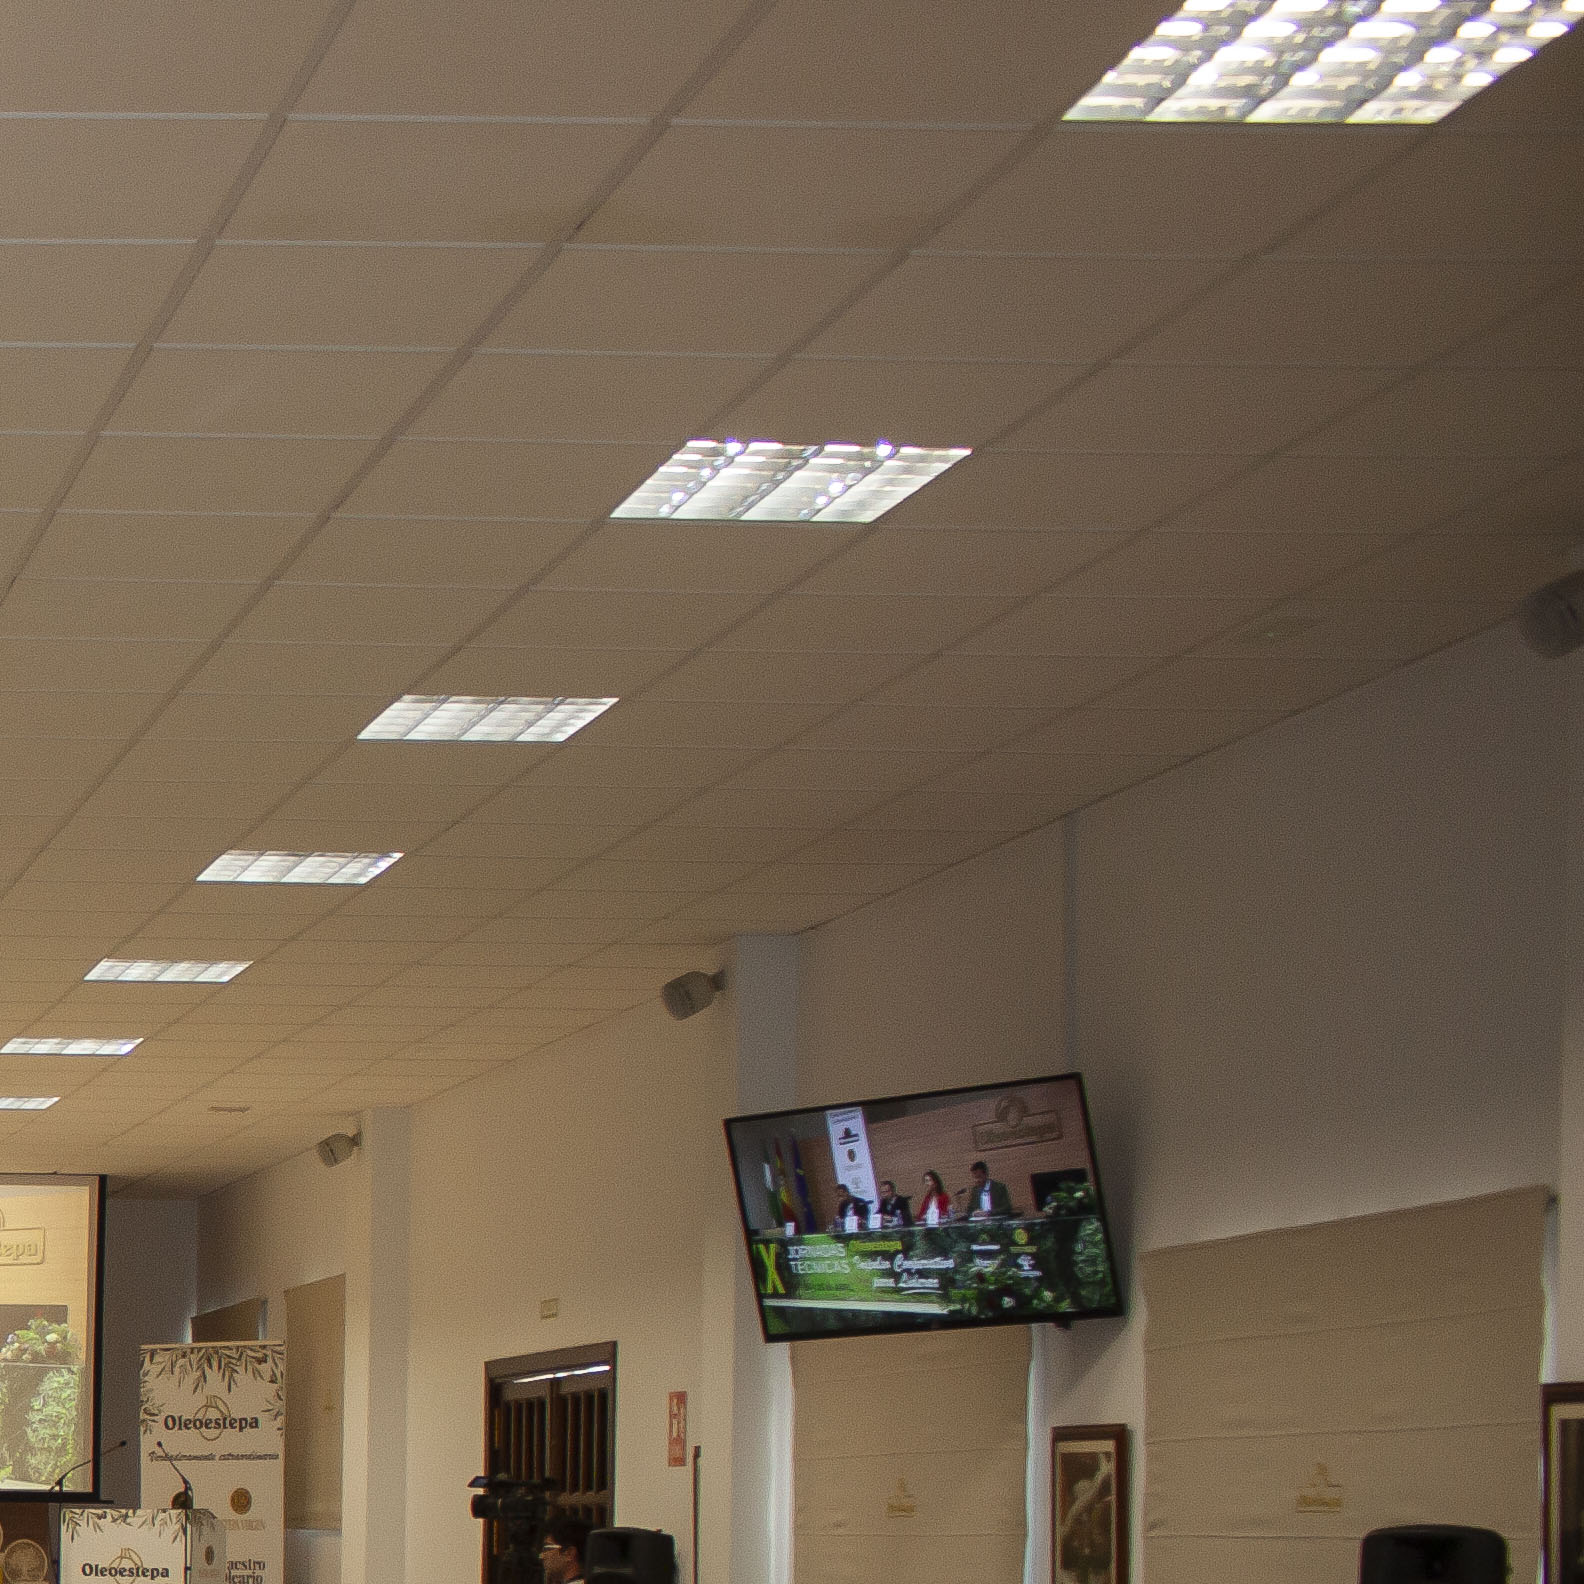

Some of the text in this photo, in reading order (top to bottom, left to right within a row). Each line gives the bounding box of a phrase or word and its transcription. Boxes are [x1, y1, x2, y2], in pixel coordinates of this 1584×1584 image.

[164, 1414, 260, 1433] Oleoestepa
[82, 1562, 170, 1580] Oleoestepa
[227, 1558, 265, 1571] aestro
[225, 1570, 264, 1584] leario
